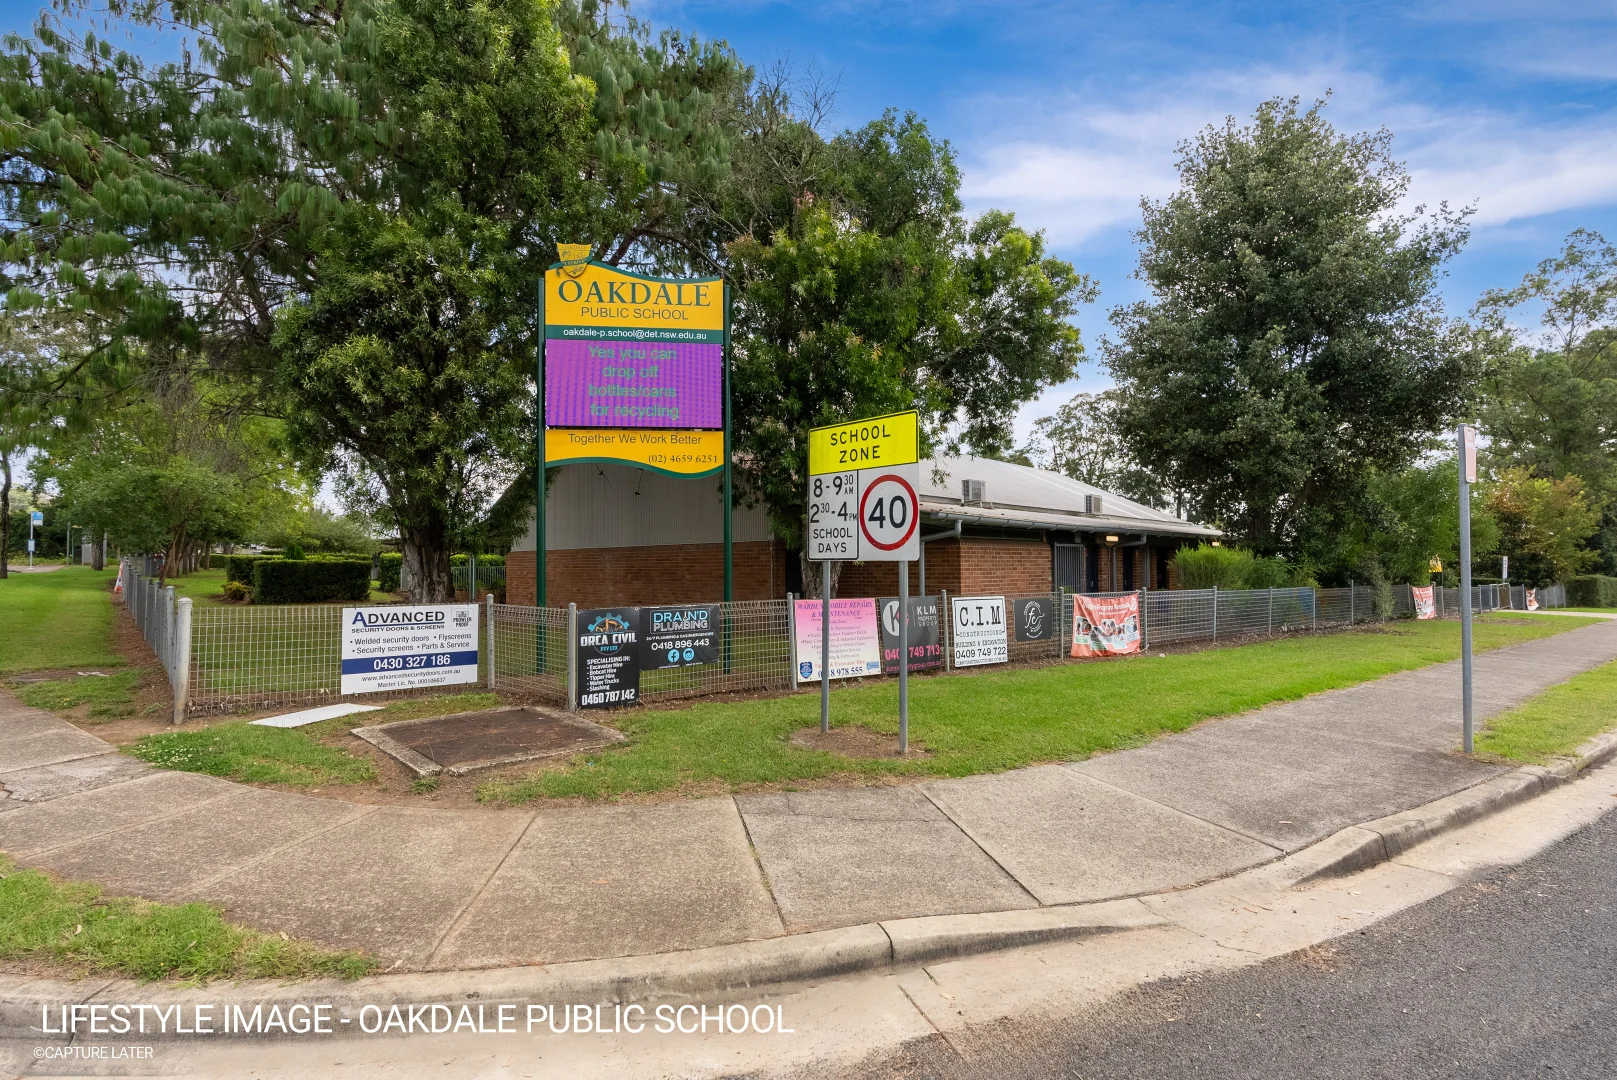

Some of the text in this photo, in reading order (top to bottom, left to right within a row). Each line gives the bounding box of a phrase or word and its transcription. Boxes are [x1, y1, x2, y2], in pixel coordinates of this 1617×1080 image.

[558, 280, 710, 306] OAKDALE
[582, 306, 688, 320] PUBLIC SCHOOL
[564, 328, 706, 340] oakdale-p.school@det.nsw.edu.au
[588, 345, 676, 361] Yes you can
[602, 365, 659, 380] drop off
[590, 403, 679, 420] for recycling
[568, 434, 701, 445] Together We Work Better
[831, 425, 890, 445] SCHOOL
[648, 455, 717, 464] (02) 4659 6251
[840, 445, 880, 463] ZONE
[868, 496, 907, 529] 40
[813, 528, 852, 539] SCHOOL
[819, 542, 846, 553] DAYS
[917, 606, 936, 615] KLM
[960, 606, 1001, 626] C.I.M
[352, 611, 445, 625] ADVANCED
[654, 620, 708, 632] PLUMBING
[438, 633, 472, 641] Flyscreens
[581, 633, 637, 646] ORCA CIVIL
[357, 646, 385, 654] Security
[652, 642, 673, 650] 0418
[675, 640, 692, 648] 896
[909, 646, 924, 658] 749
[926, 645, 940, 656] 713
[956, 647, 1006, 659] 0409 749 722
[374, 654, 450, 670] 0430 327 186
[587, 657, 622, 665] SPECIALISING
[836, 668, 850, 676] 978
[851, 666, 863, 675] 555
[582, 689, 635, 705] 0460 787 142
